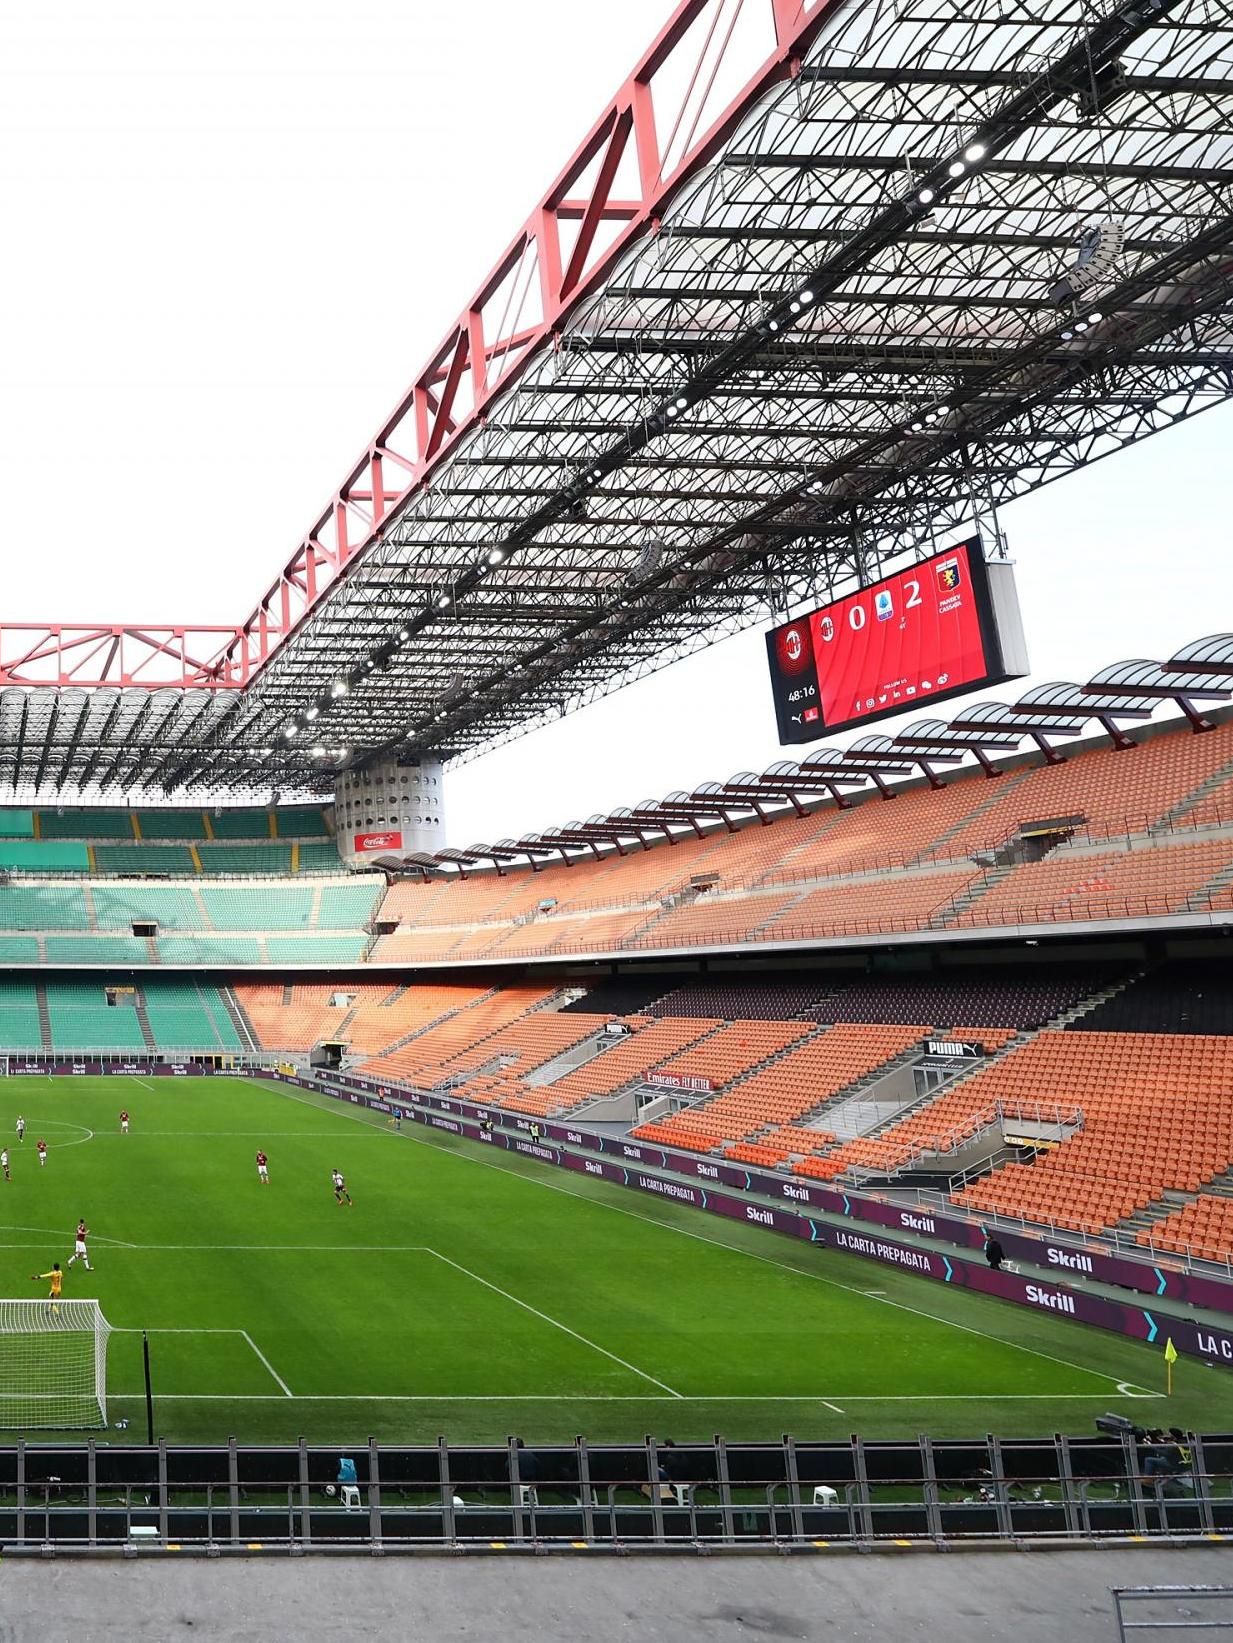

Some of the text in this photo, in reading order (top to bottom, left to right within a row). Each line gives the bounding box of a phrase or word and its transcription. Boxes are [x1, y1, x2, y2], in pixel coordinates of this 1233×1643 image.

[849, 581, 922, 630] 0 2
[788, 685, 815, 702] 48:16
[929, 1042, 963, 1055] PUMA
[648, 1073, 679, 1086] Emirates
[692, 1078, 709, 1089] BETTER
[568, 1133, 581, 1144] Skrill
[624, 1146, 640, 1158] Skrill
[586, 1162, 602, 1175] Skrill
[697, 1164, 718, 1177] Skrill
[640, 1176, 694, 1201] LA CARTA PREPAGATA
[783, 1184, 809, 1201] Skrill
[746, 1207, 774, 1225] Skrill
[900, 1213, 935, 1233] Skrill
[836, 1232, 931, 1271] LA CARTA PREPAGATA
[1048, 1248, 1093, 1272] Skrill
[1026, 1285, 1075, 1314] Skrill
[1198, 1333, 1218, 1355] LA
